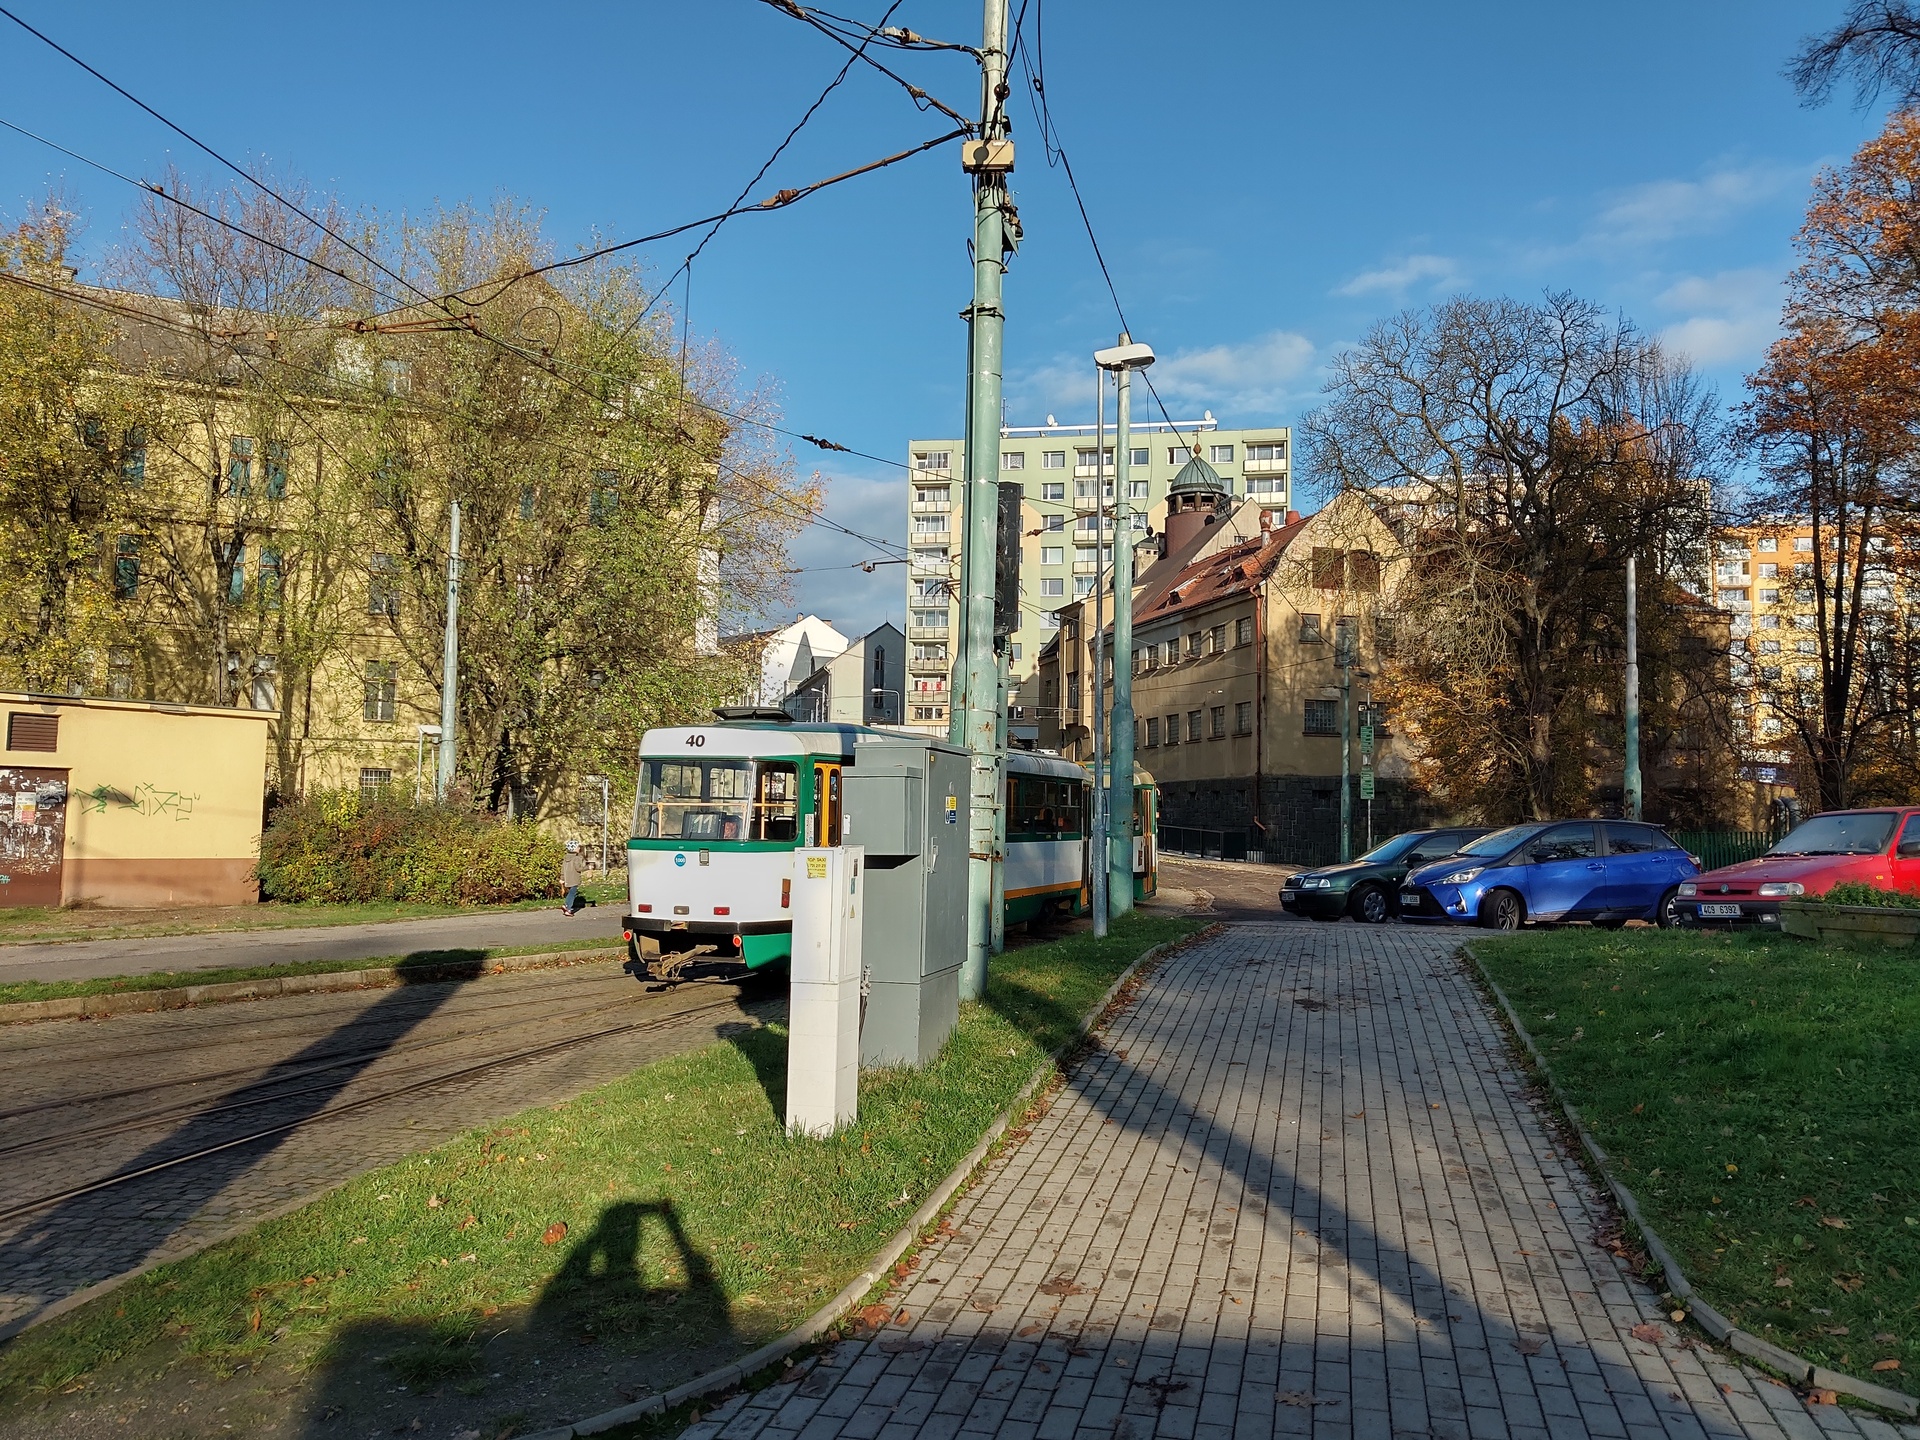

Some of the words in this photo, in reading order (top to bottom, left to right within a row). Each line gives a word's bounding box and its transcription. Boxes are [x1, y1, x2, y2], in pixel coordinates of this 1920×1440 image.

[685, 734, 706, 748] 40
[693, 814, 713, 834] 11
[1719, 905, 1737, 914] 6392
